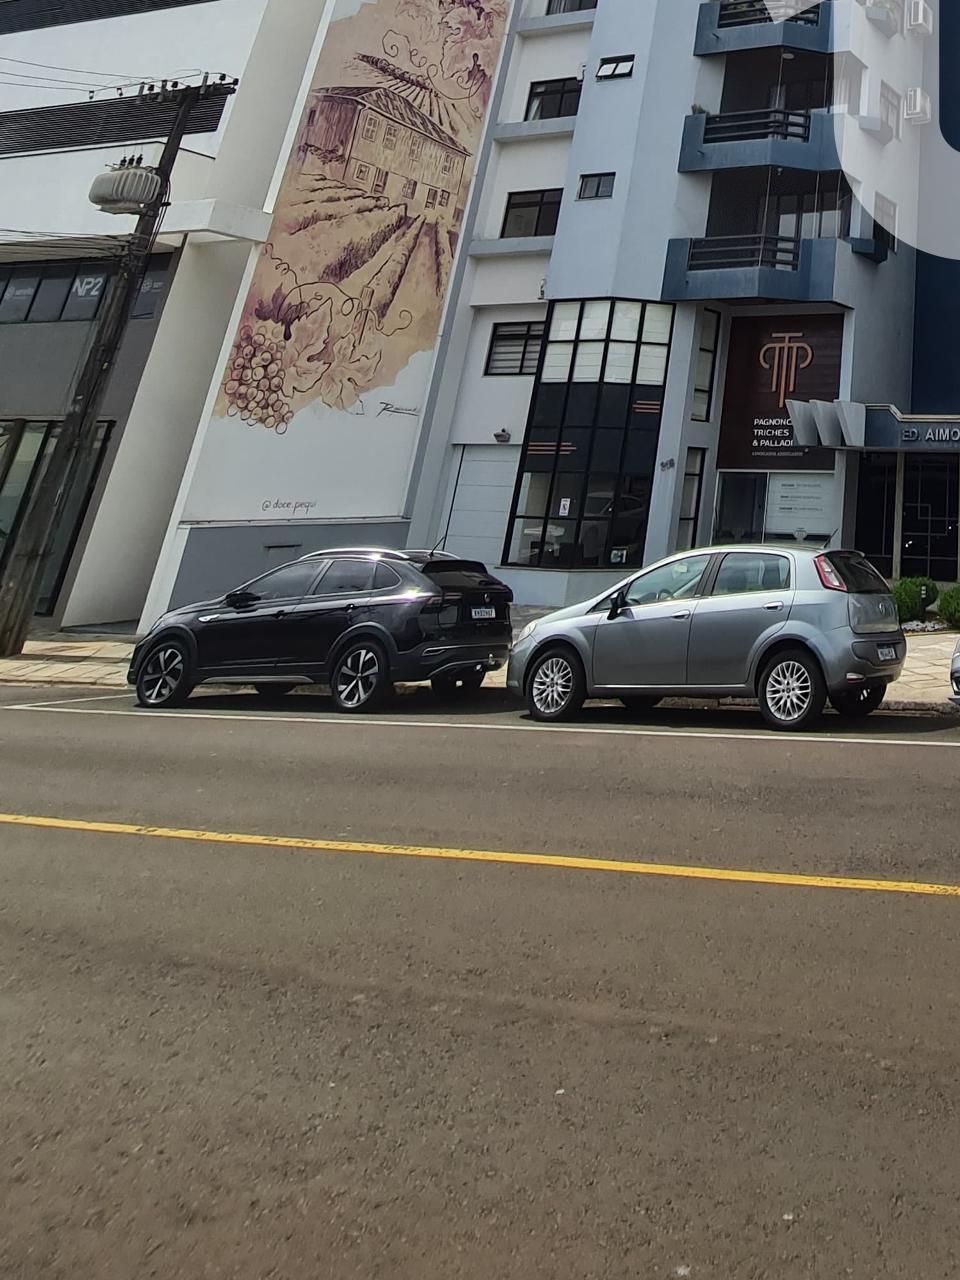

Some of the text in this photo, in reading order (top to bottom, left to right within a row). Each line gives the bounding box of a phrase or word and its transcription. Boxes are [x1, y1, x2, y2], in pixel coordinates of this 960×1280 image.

[72, 277, 103, 297] NP2
[753, 429, 790, 437] TRICHES
[752, 439, 758, 447] &
